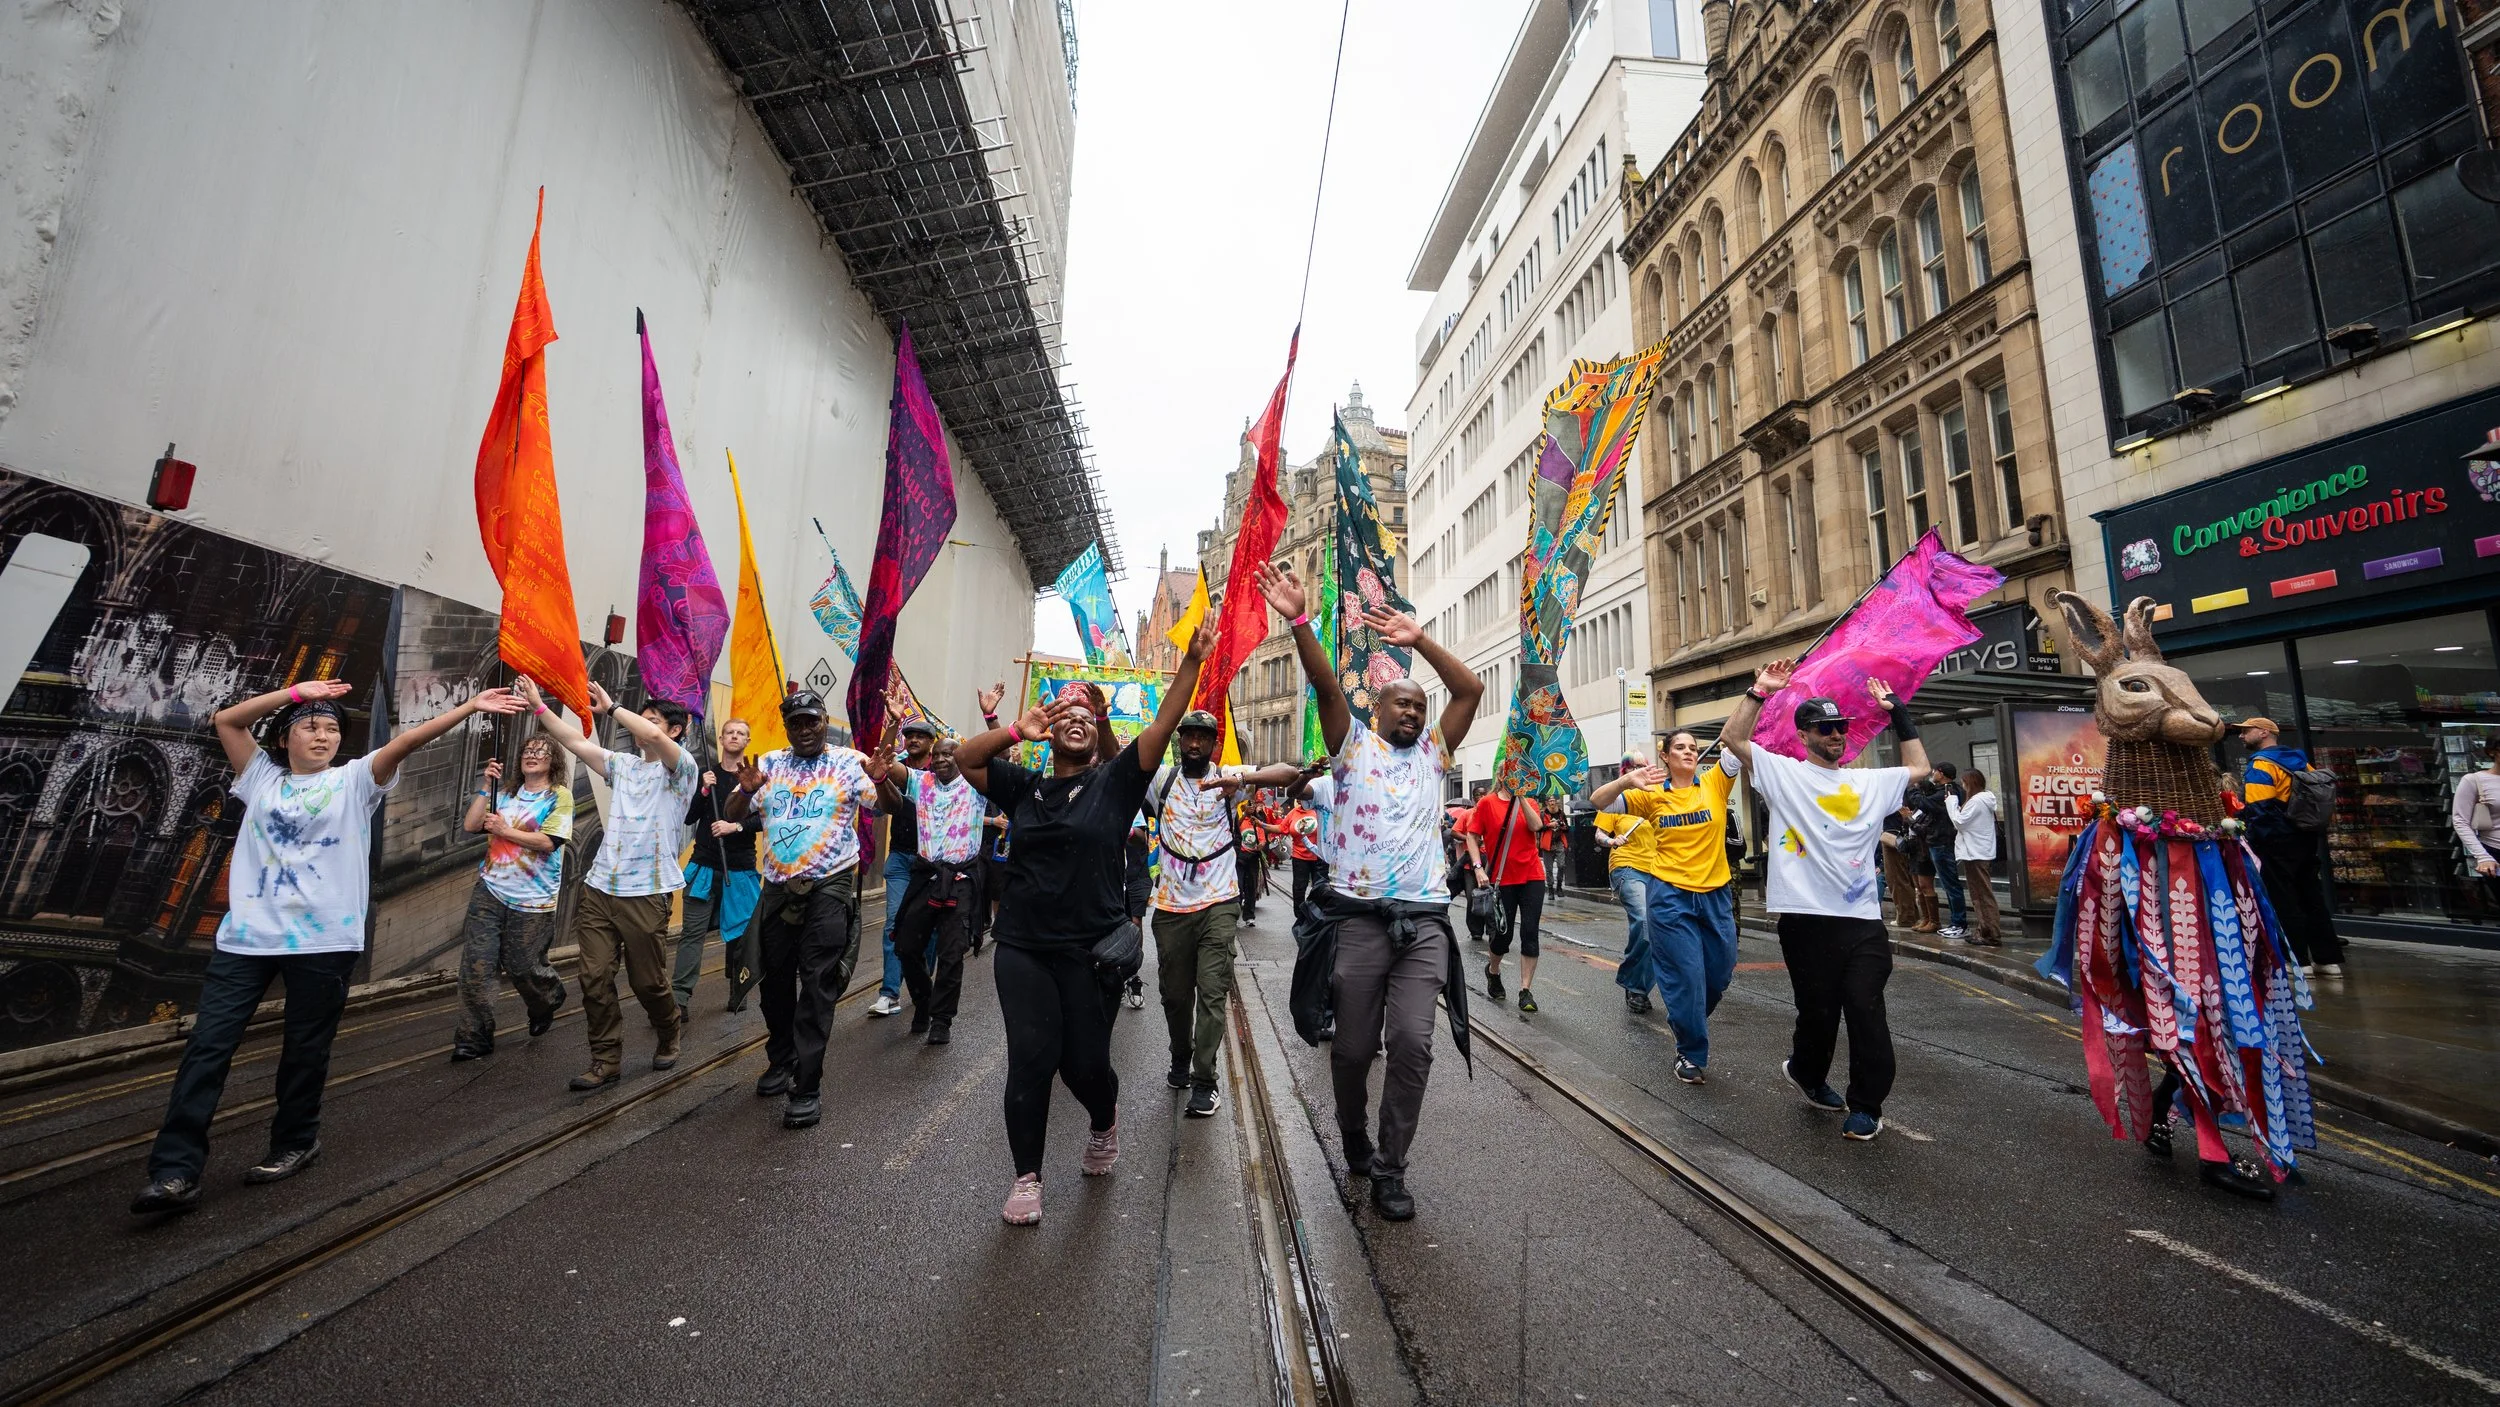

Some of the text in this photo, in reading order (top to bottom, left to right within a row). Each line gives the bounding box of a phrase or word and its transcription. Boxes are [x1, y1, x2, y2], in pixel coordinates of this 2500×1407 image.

[2172, 464, 2369, 556] Convenience
[2239, 487, 2449, 558] & Souvenirs
[2123, 562, 2159, 579] VAPE SHOP
[2383, 556, 2419, 571] SANDWICH
[2290, 578, 2316, 591] TOBACCO
[517, 610, 528, 621] of
[813, 674, 830, 686] 10
[2048, 766, 2065, 774] THE
[772, 789, 825, 820] SBC
[1659, 809, 1712, 828] SANCTUARY
[2029, 816, 2059, 825] KEEPS
[1363, 837, 1399, 855] WELCOME
[2051, 868, 2063, 876] With
